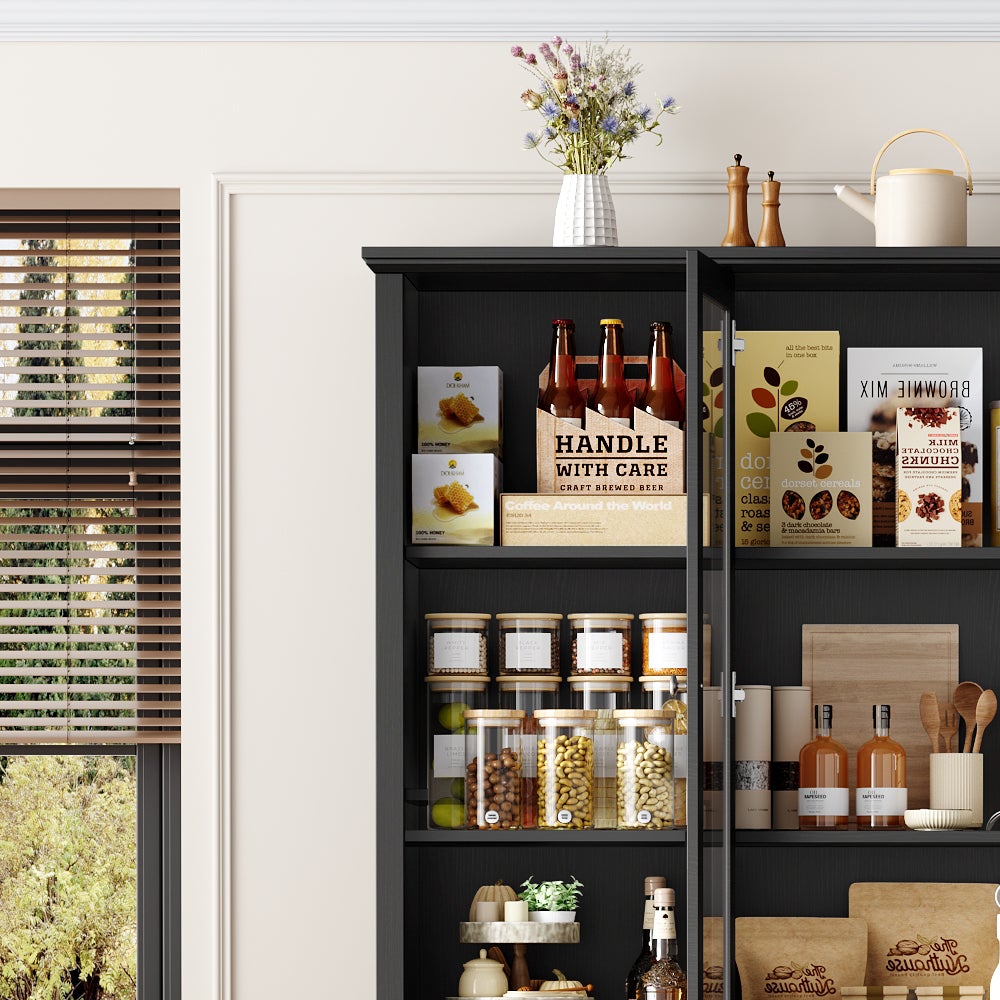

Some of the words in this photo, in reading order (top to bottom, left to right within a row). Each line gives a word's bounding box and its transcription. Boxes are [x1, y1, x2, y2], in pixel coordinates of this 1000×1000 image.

[555, 435, 668, 454] HANDLE
[556, 463, 609, 477] WITH
[616, 463, 668, 477] CARE
[781, 478, 818, 488] dorset
[819, 478, 861, 488] cereals
[504, 500, 551, 512] Coffee
[553, 500, 604, 512] Around
[606, 500, 630, 512] the
[631, 500, 673, 512] World
[741, 509, 770, 518] roas
[750, 538, 770, 547] glorio
